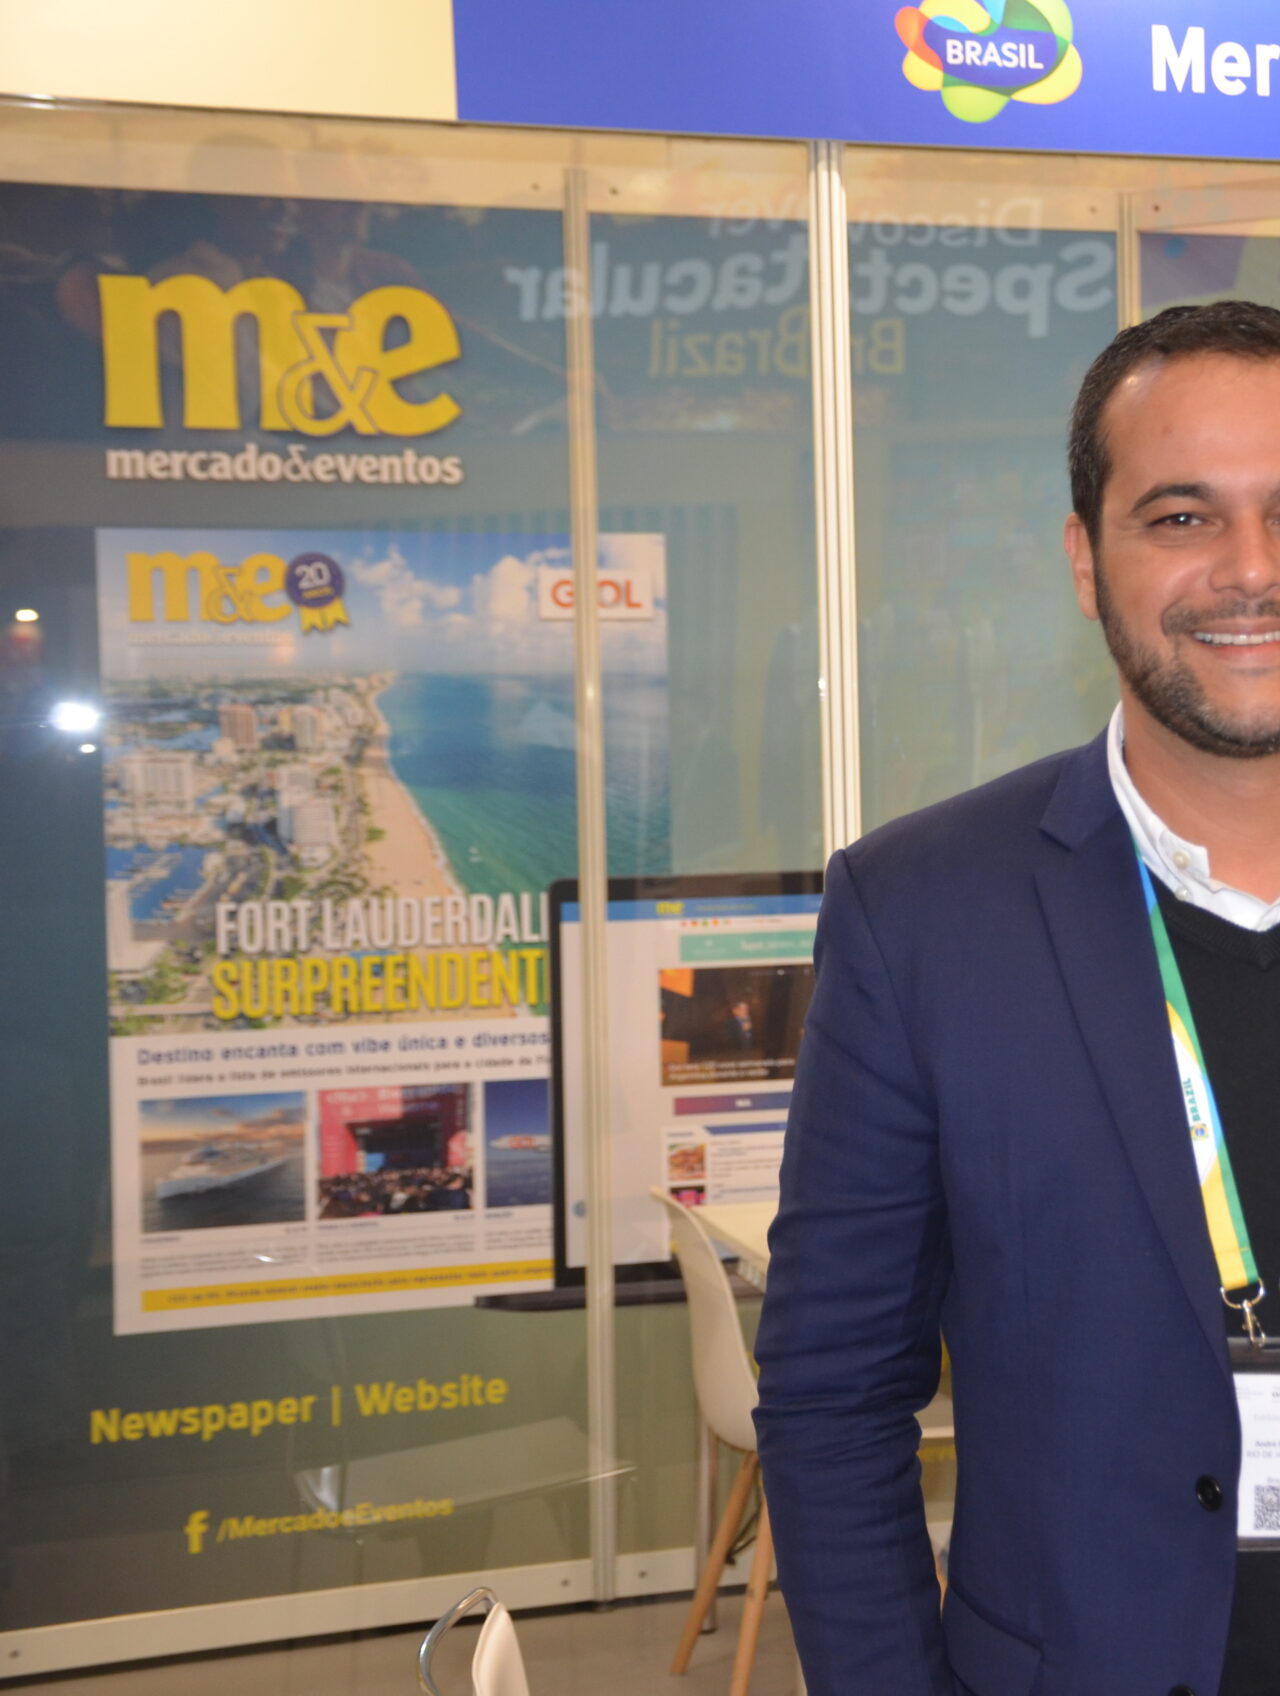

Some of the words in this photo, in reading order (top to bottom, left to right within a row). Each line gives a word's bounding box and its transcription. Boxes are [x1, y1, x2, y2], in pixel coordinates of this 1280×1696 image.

[945, 38, 1045, 71] BRASIL
[98, 273, 463, 437] m&e
[105, 442, 465, 485] mercado&eventos
[125, 552, 294, 624] m&e
[294, 561, 332, 590] 20
[549, 578, 645, 609] GOL
[215, 899, 314, 955] FORT
[211, 947, 550, 1021] SURPREENDENT
[137, 1047, 213, 1066] Destino
[221, 1041, 299, 1060] encanta
[305, 1041, 346, 1056] com
[1183, 1078, 1202, 1122] BRAZIL
[90, 1393, 318, 1445] Newspaper
[354, 1374, 509, 1418] Website
[215, 1497, 455, 1543] /MercadoeEventos
